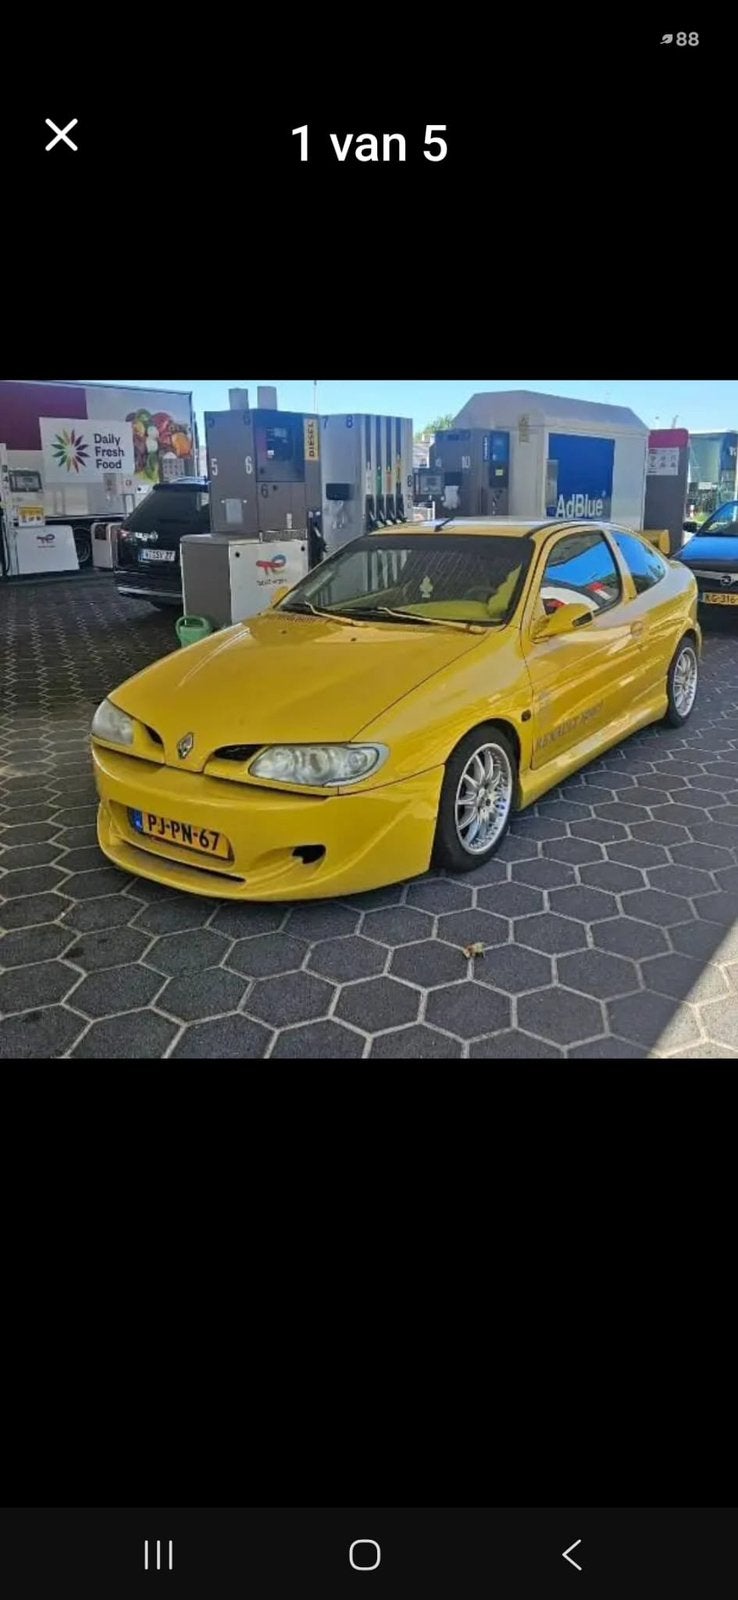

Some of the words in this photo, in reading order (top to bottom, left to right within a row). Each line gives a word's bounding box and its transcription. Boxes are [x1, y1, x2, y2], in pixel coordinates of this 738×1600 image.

[94, 433, 121, 446] Daily
[307, 421, 315, 457] DIESEL
[95, 446, 125, 458] Fresh
[96, 459, 122, 470] Food
[210, 458, 218, 476] 5
[245, 456, 252, 474] 6
[261, 484, 269, 498] 6
[147, 813, 220, 851] PJ-PN-67
